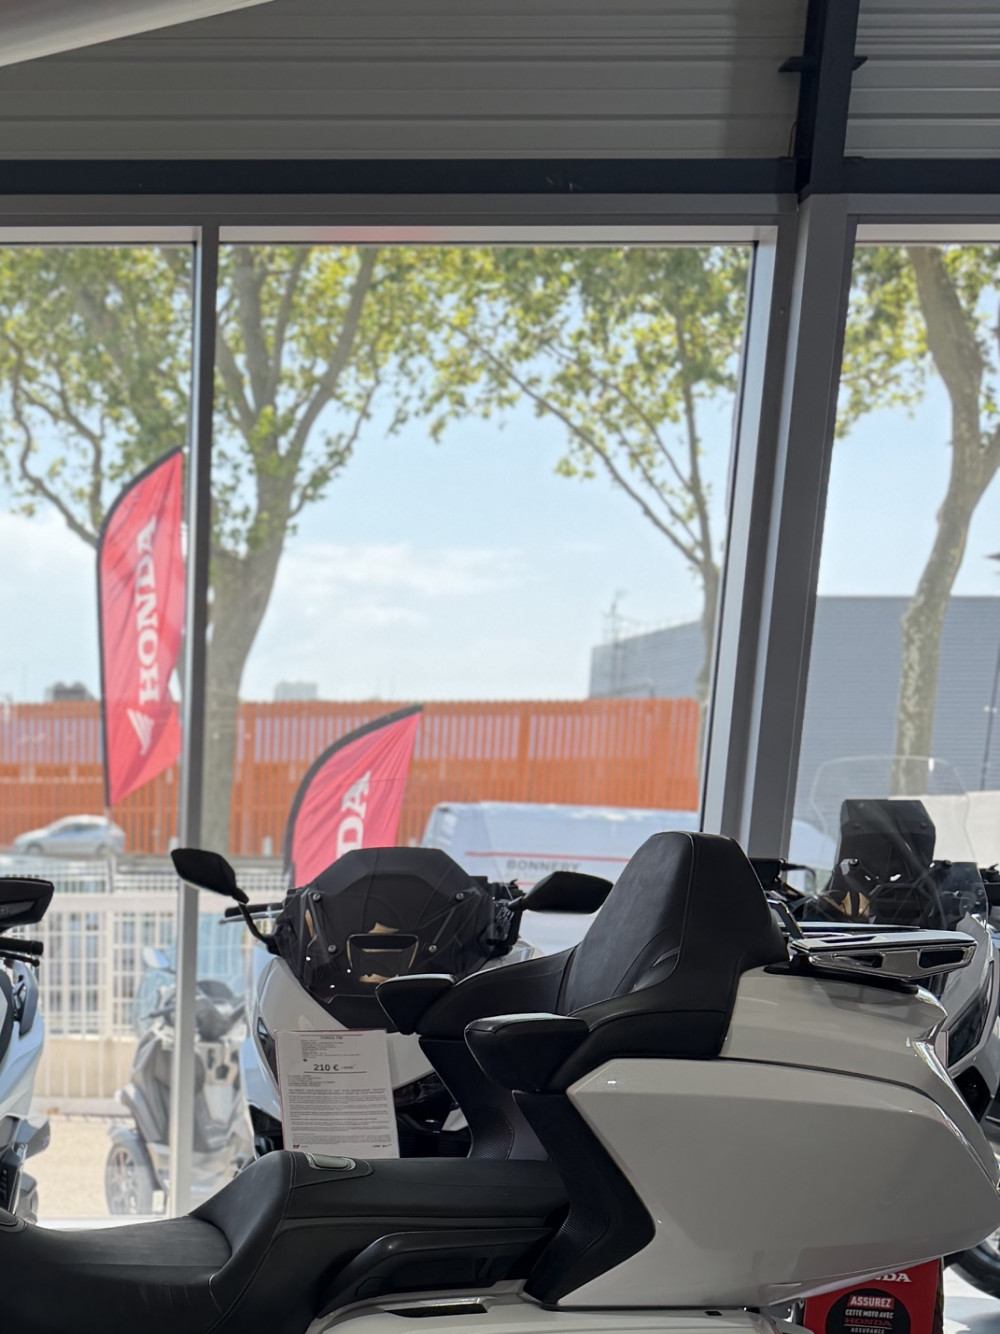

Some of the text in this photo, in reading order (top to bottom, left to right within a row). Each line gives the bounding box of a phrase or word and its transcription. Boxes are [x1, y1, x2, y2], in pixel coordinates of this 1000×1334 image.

[134, 515, 160, 706] HONDA
[313, 1063, 331, 1071] 210
[850, 1296, 891, 1307] ASSUREZ
[845, 1309, 862, 1317] CETTE
[863, 1310, 879, 1318] MOTO
[845, 1318, 892, 1327] HONDA
